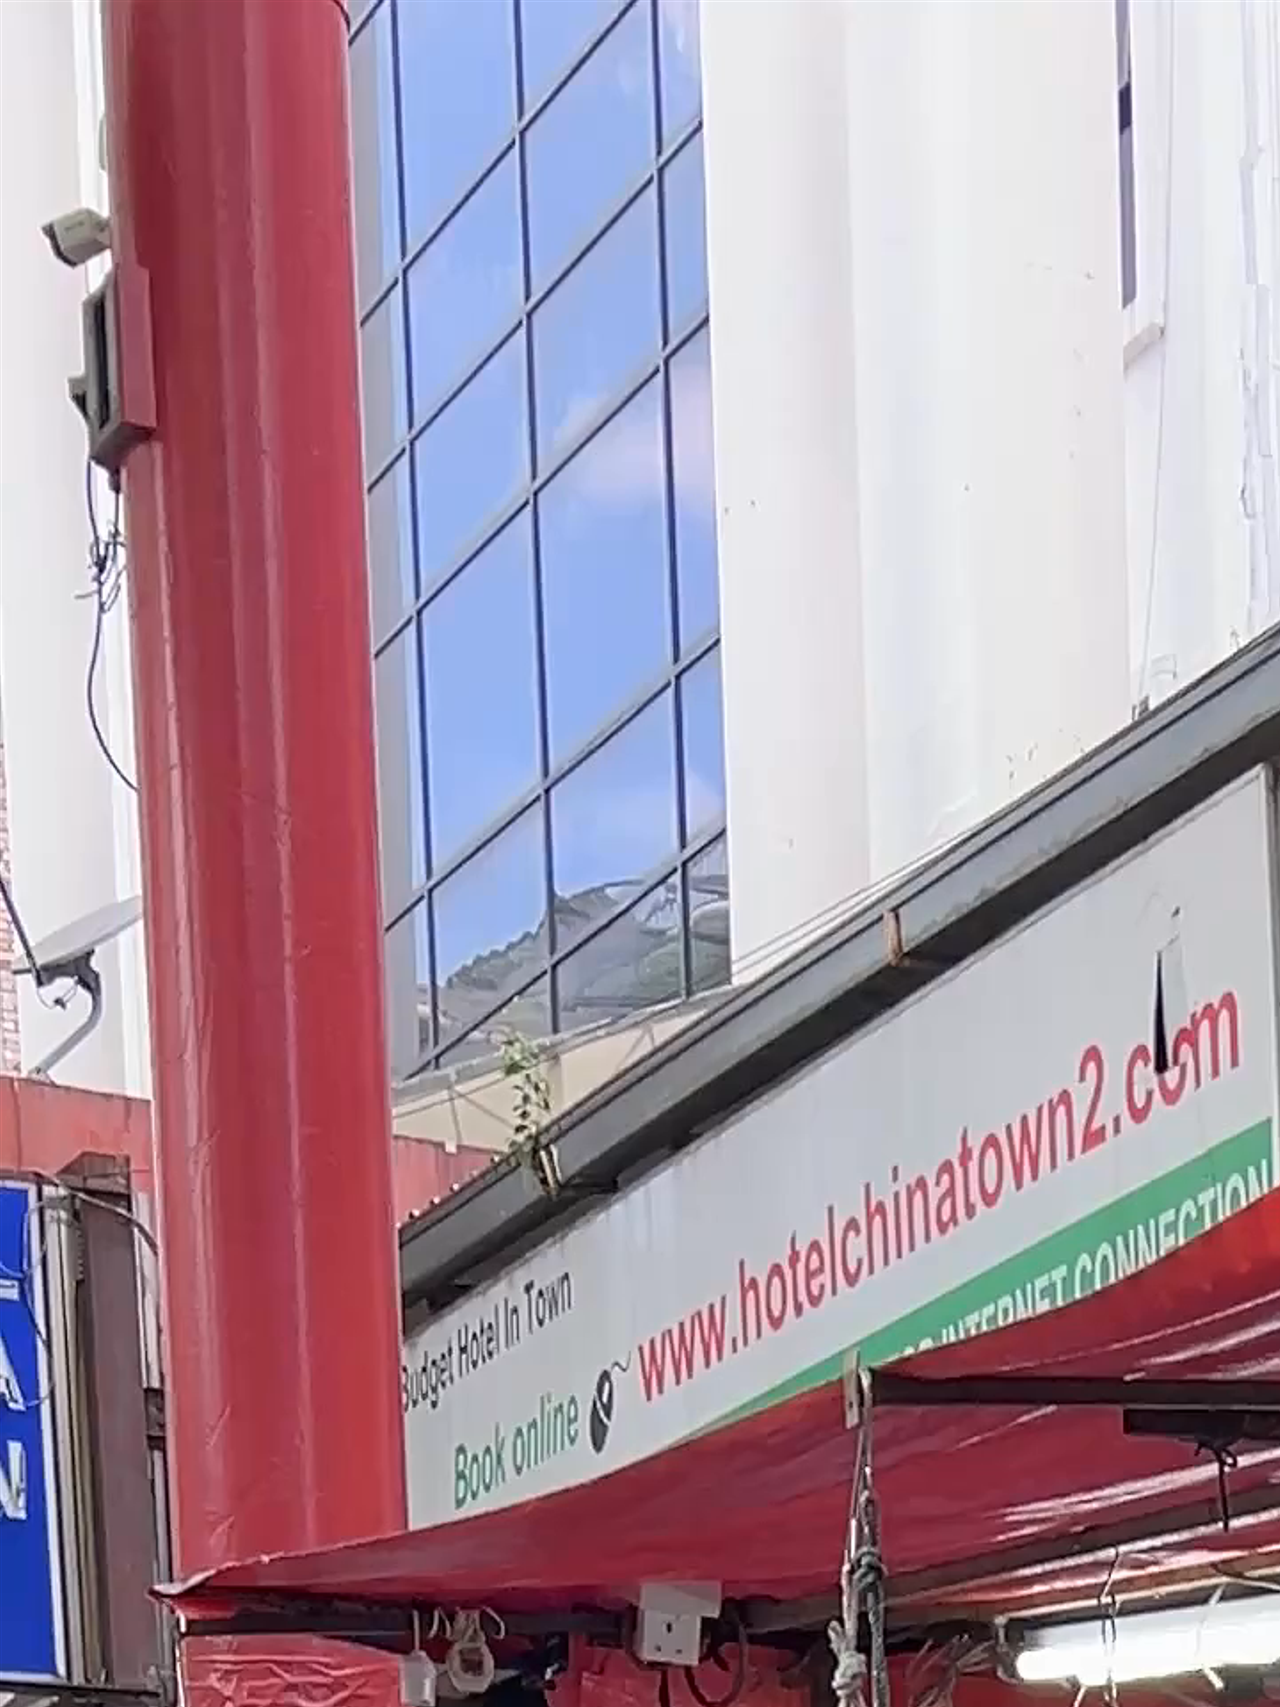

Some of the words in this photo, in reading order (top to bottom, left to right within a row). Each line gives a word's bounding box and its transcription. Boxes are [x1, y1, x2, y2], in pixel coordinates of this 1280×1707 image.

[457, 1303, 500, 1379] Hotel
[503, 1296, 521, 1351] In
[523, 1271, 573, 1335] Town
[454, 1420, 506, 1510] Book
[511, 1394, 580, 1477] online
